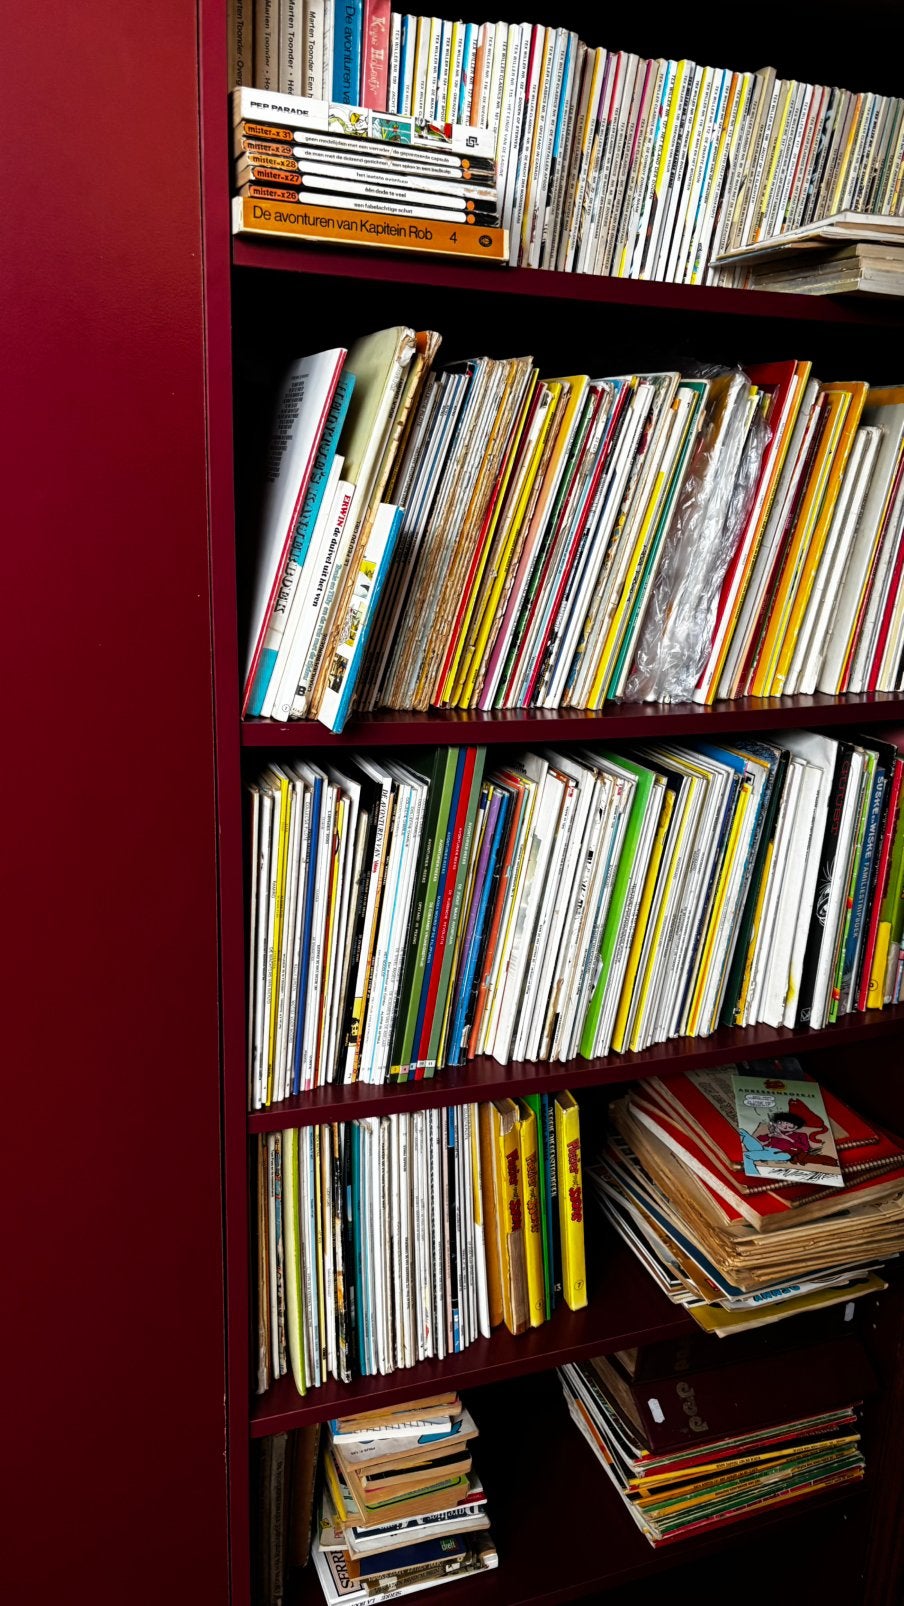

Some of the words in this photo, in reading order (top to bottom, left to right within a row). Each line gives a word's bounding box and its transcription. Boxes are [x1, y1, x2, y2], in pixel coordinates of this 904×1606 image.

[344, 5, 355, 24] De
[340, 26, 354, 88] avonturen
[271, 104, 309, 116] PARADE
[286, 160, 296, 168] 28
[290, 174, 299, 183] 27
[286, 191, 296, 199] 26
[253, 206, 271, 220] De
[274, 210, 334, 228] avonturen
[336, 220, 357, 230] van
[360, 217, 406, 238] Kapitein
[409, 226, 433, 240] Rob
[450, 232, 457, 243] 4
[336, 494, 351, 527] ERWIN
[333, 526, 341, 537] de
[325, 537, 338, 564] duivel
[321, 564, 330, 577] uit
[317, 577, 326, 591] het
[312, 592, 321, 607] ven
[381, 788, 388, 799] DE
[872, 775, 884, 814] SUSKE
[375, 800, 387, 838] AVONTUREN
[374, 840, 382, 857] VAN
[865, 822, 877, 859] WISKE
[852, 861, 870, 938] FAMILIESTRIPBOEK
